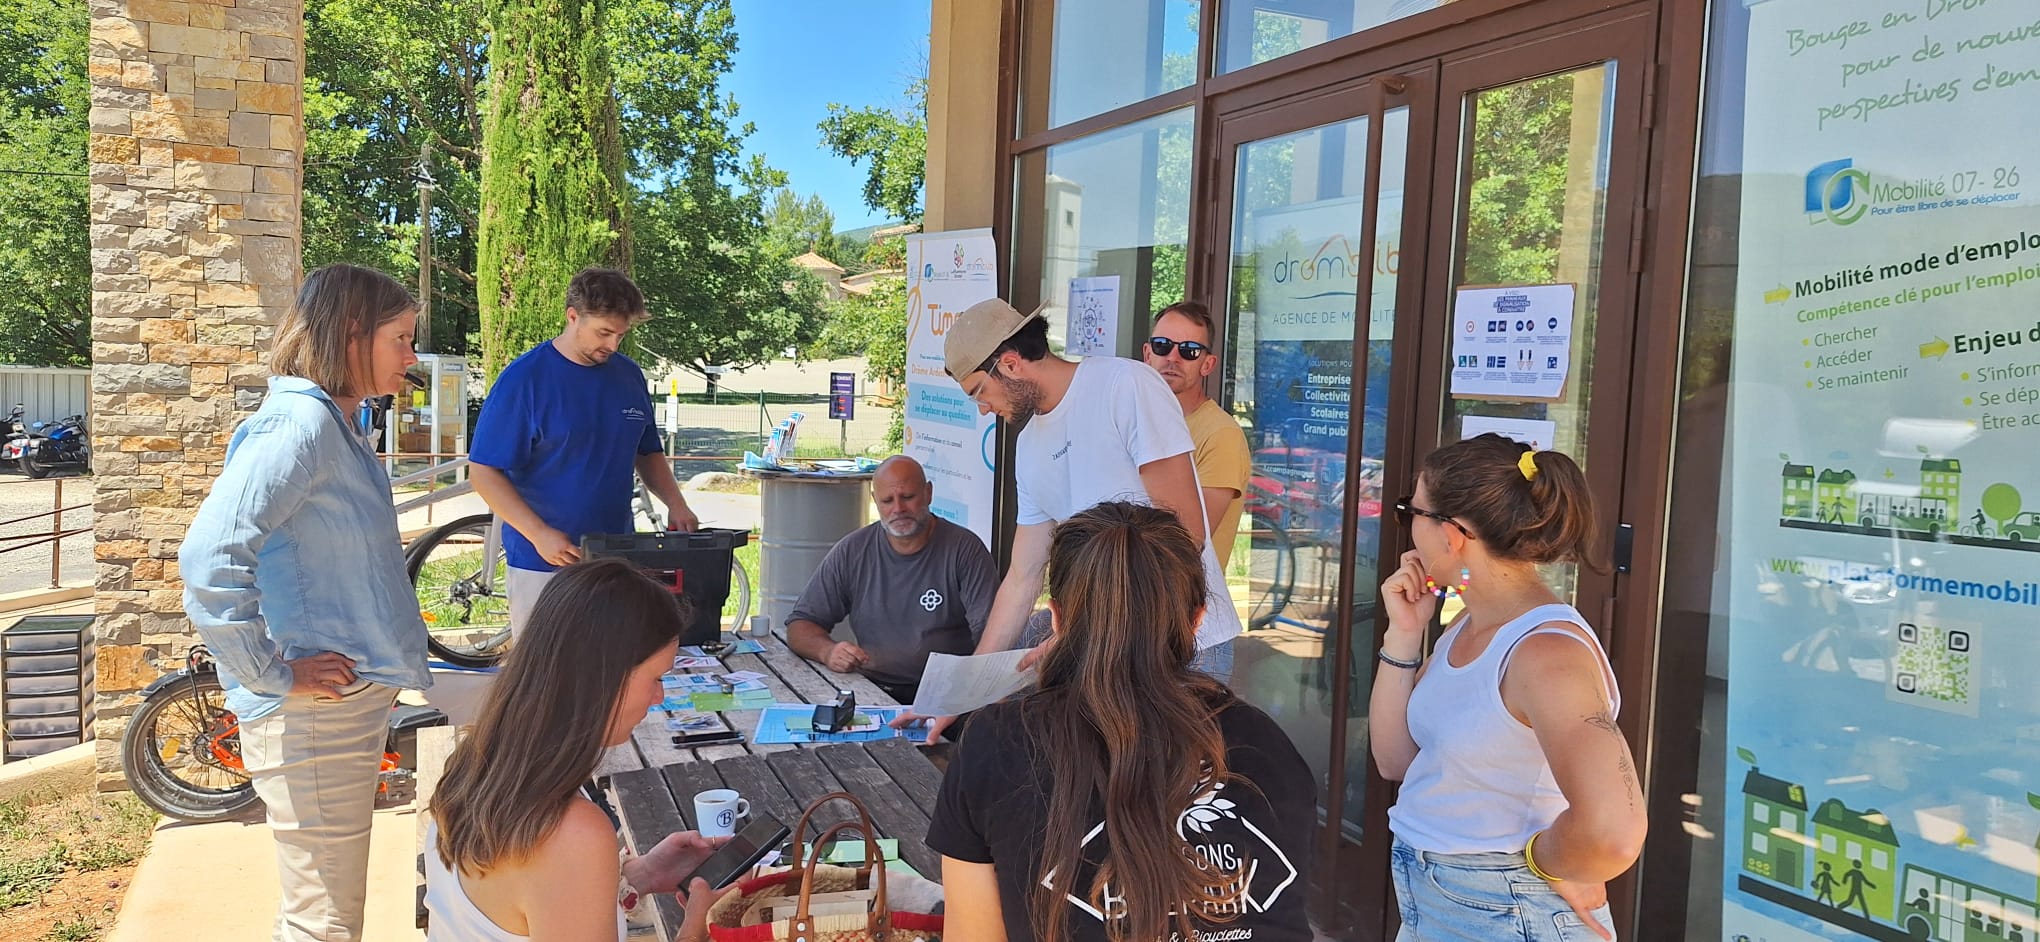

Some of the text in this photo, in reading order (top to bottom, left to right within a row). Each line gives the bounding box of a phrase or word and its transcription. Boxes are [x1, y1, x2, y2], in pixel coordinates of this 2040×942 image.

[1786, 0, 1987, 56] Bougez en Dro
[1841, 19, 2040, 88] pour de nouve
[1817, 78, 1961, 131] perspectives
[1872, 176, 1946, 205] Mobilité
[1993, 165, 2020, 190] 26
[1870, 192, 2021, 216] Pour être libre de se déplacer
[1794, 264, 1874, 299] Mobilité
[1879, 253, 1940, 280] mode
[1796, 263, 2040, 323] Compétence clé pour l'emploi
[1272, 312, 1318, 325] AGENCE
[1321, 311, 1337, 323] DE
[1814, 326, 1878, 347] Chercher
[1953, 330, 2022, 355] Enjeu
[1339, 360, 1353, 368] POU
[1816, 349, 1873, 369] Accéder
[1307, 373, 1352, 386] Entreprise
[1817, 365, 1910, 390] Se maintenir
[1304, 390, 1351, 402] Collectivit
[1979, 386, 2040, 407] Se dép
[1310, 406, 1350, 420] Scolaires
[1981, 412, 2017, 431] Être
[1303, 422, 1327, 435] Grand
